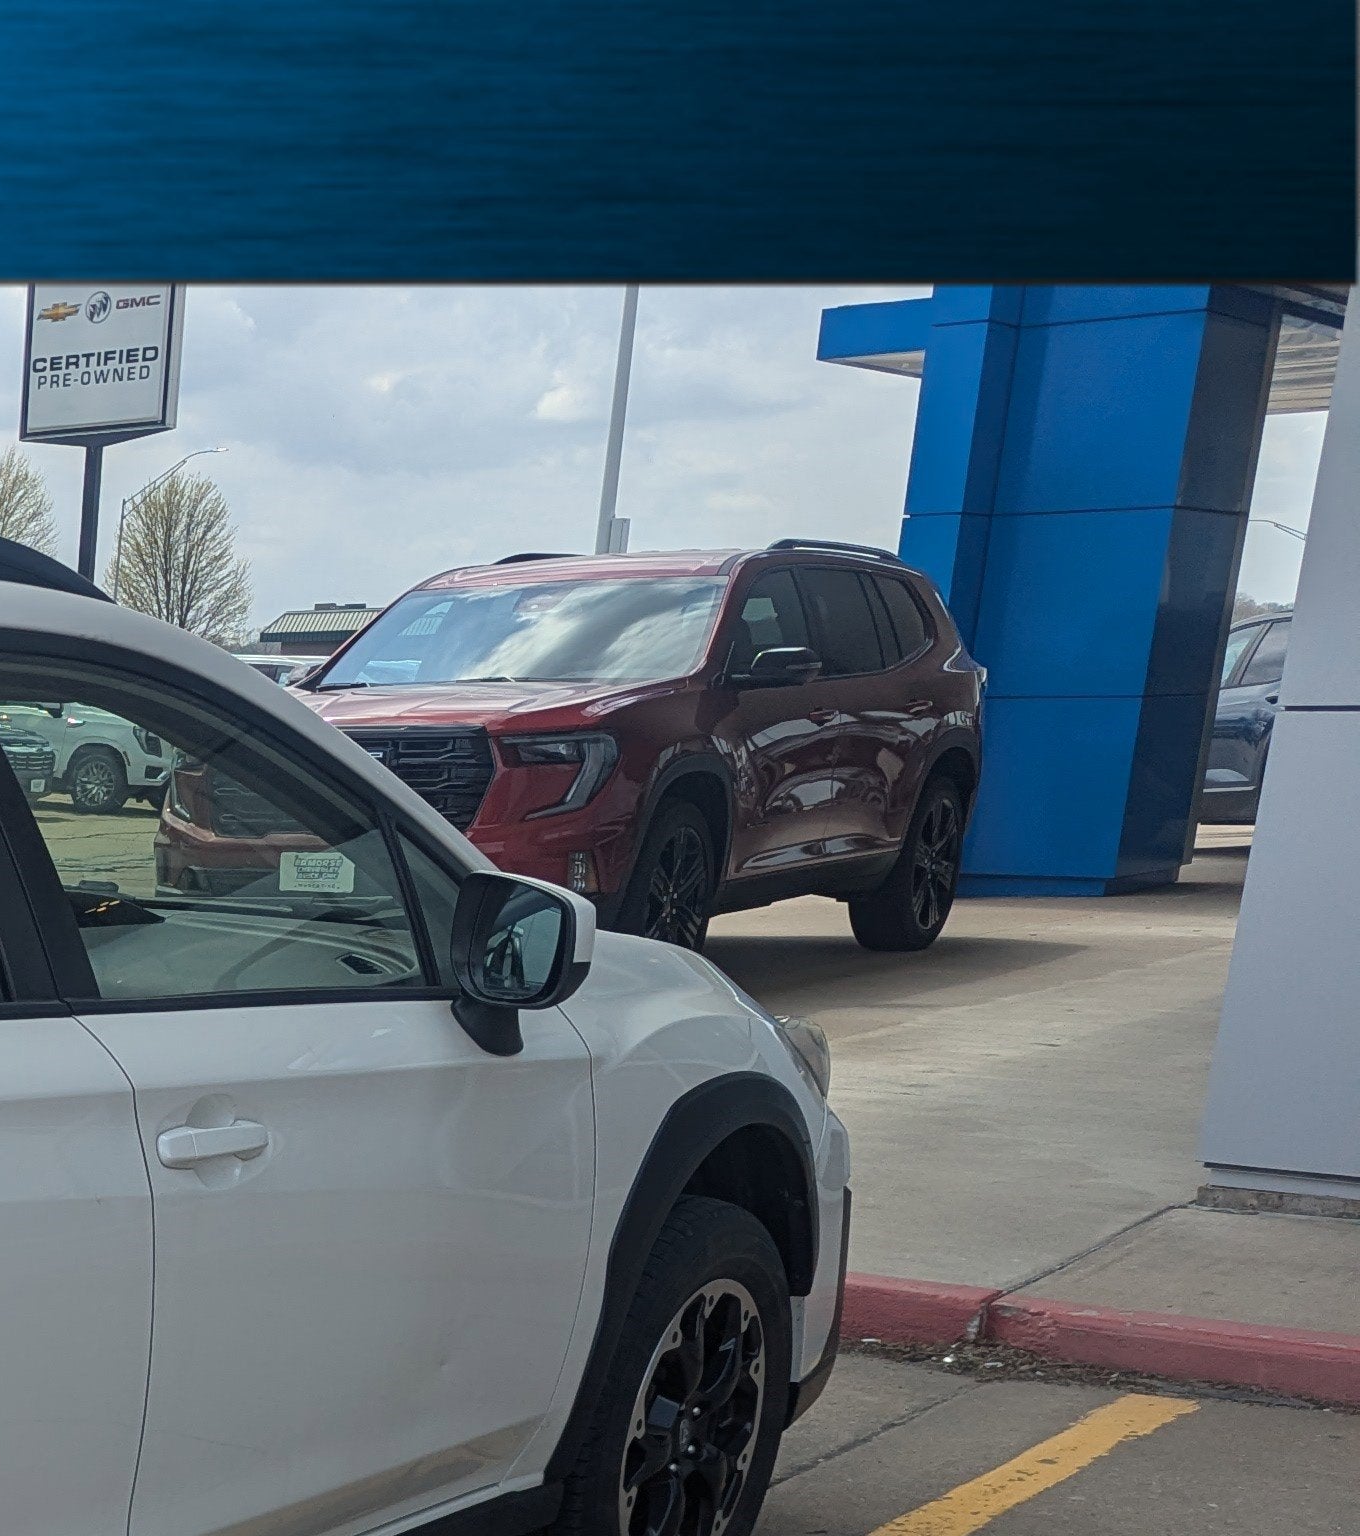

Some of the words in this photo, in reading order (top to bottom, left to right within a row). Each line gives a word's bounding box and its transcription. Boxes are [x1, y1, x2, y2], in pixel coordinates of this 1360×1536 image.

[115, 294, 161, 310] GMC
[32, 346, 159, 373] CERTIFIED
[37, 364, 150, 390] PRE-OWNED
